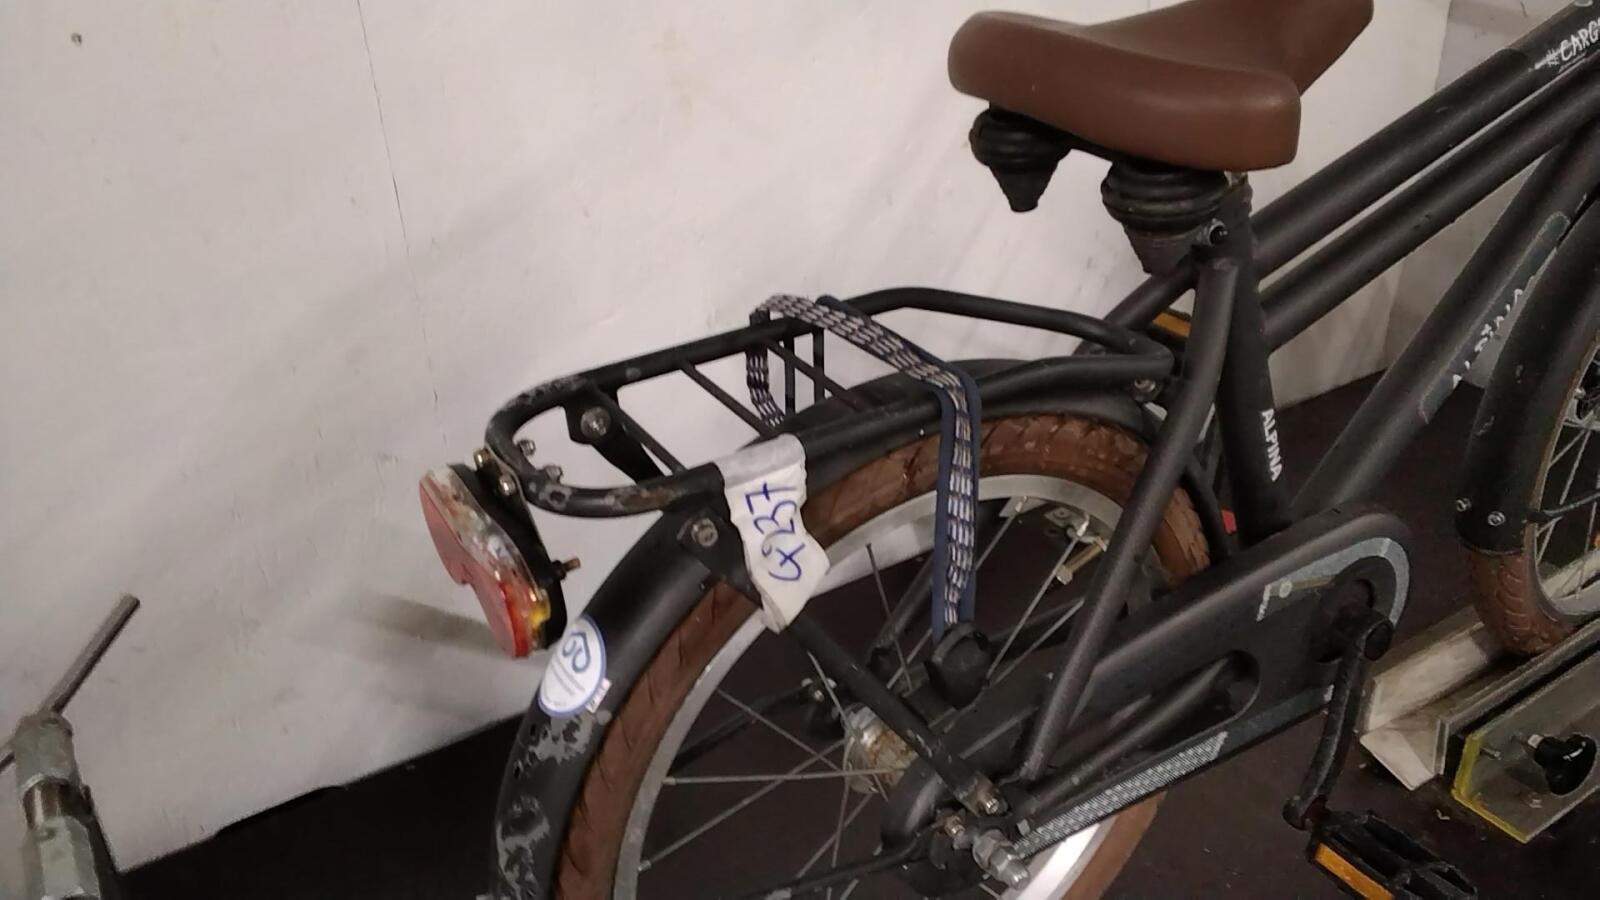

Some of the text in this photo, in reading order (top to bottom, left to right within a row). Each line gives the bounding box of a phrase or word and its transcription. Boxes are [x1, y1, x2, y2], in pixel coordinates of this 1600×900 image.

[1546, 17, 1600, 67] #CARG
[1262, 408, 1282, 482] ALPINA
[745, 482, 805, 582] 4237
